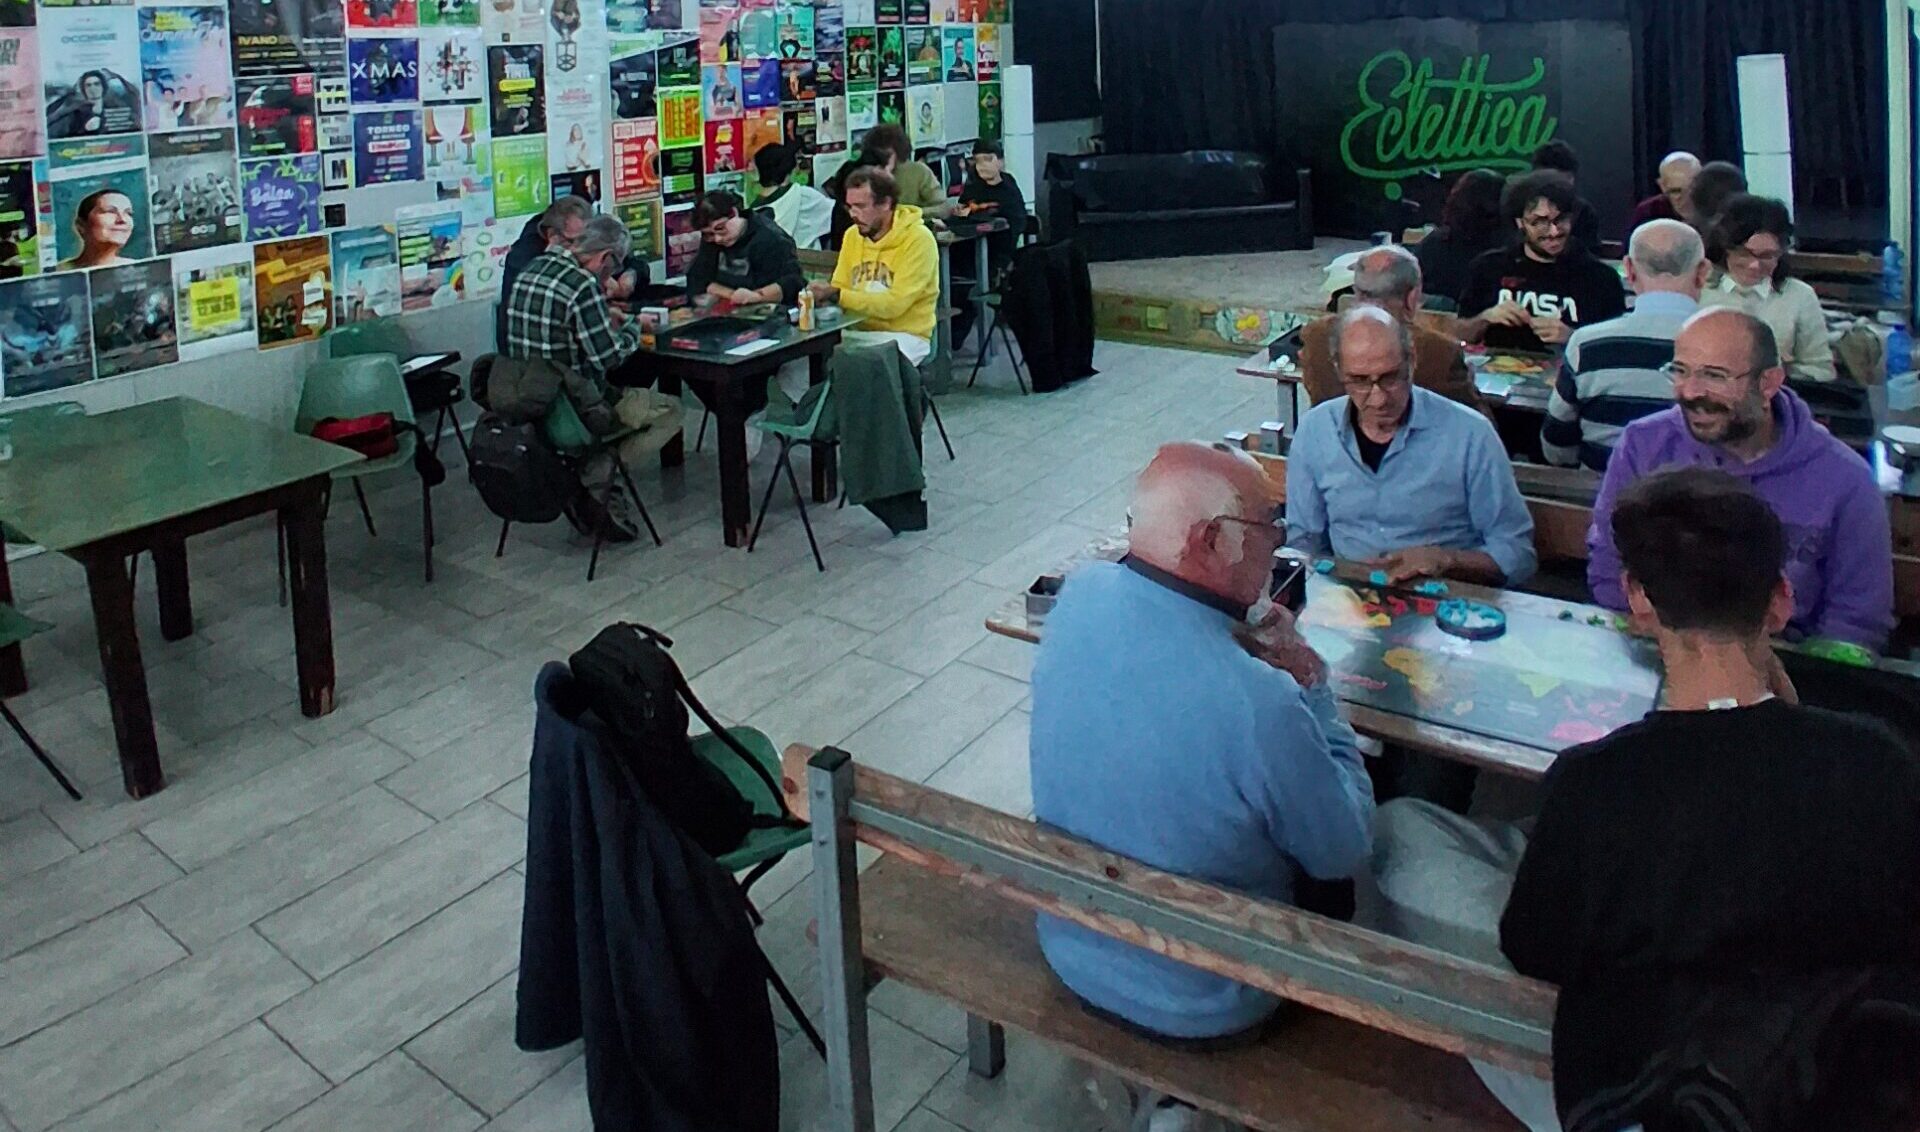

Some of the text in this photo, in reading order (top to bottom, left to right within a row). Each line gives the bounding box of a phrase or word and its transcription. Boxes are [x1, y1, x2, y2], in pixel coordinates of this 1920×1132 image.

[351, 60, 417, 79] XMAS
[1340, 50, 1558, 178] Eclettica
[367, 124, 410, 135] TORNEO
